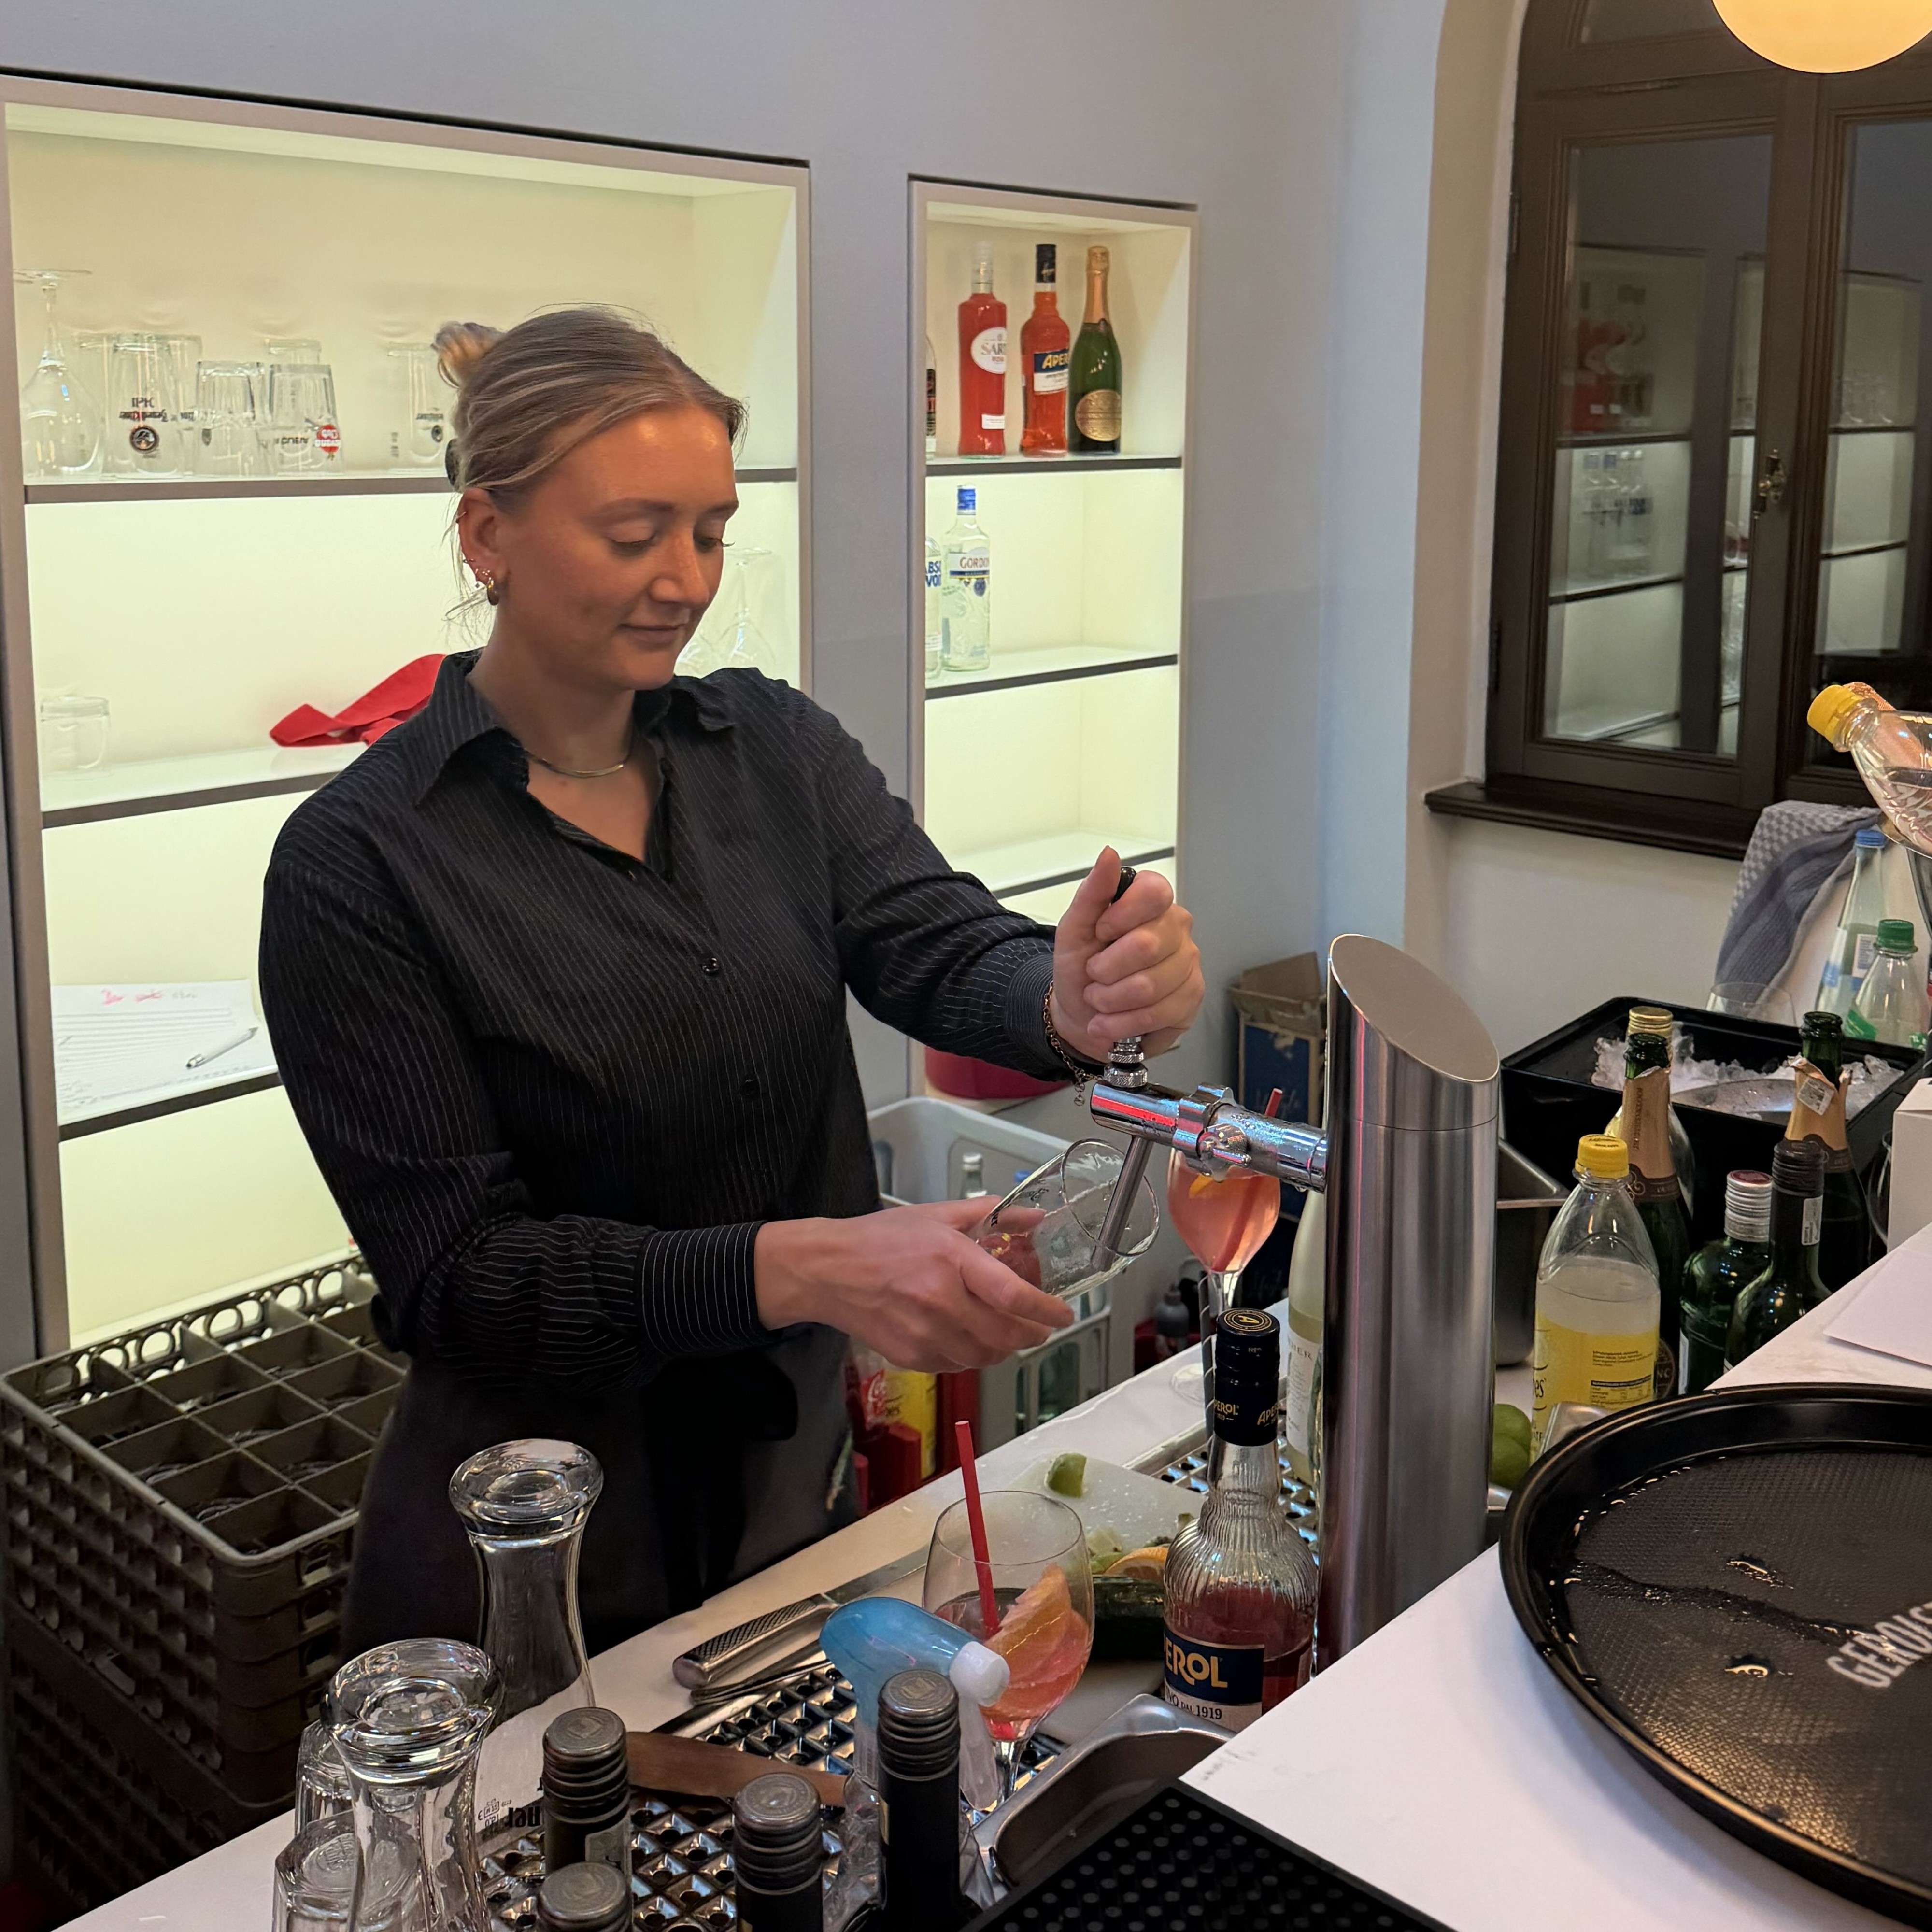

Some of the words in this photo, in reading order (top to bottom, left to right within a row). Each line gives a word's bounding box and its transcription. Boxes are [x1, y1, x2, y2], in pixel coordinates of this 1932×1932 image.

[1165, 1637, 1228, 1688] EROL
[1196, 1705, 1222, 1720] 1919
[505, 1805, 541, 1828] ner
